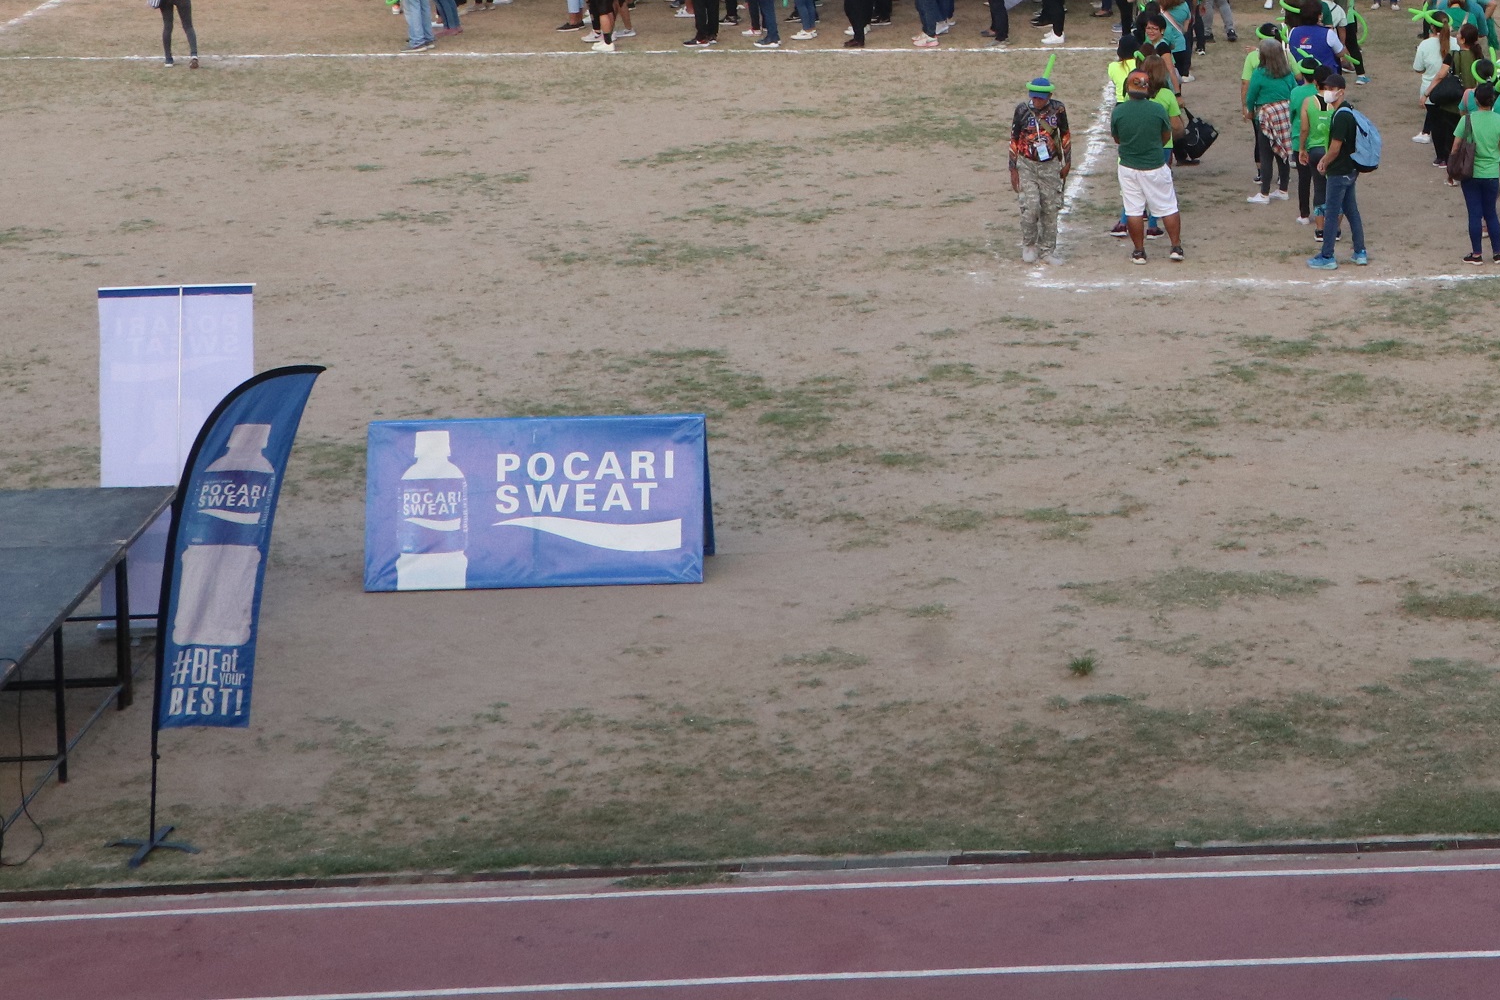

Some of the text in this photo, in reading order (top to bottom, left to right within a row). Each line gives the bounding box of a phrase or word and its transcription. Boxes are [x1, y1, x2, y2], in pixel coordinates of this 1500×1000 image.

[495, 450, 675, 483] POCARI
[200, 483, 268, 498] POCARI
[403, 491, 462, 504] POCARI
[495, 482, 659, 514] SWEAT
[198, 494, 260, 508] SWEAT
[403, 503, 458, 516] SWEAT
[170, 648, 239, 686] #BE at
[220, 672, 246, 688] your
[168, 686, 244, 716] BEST!
